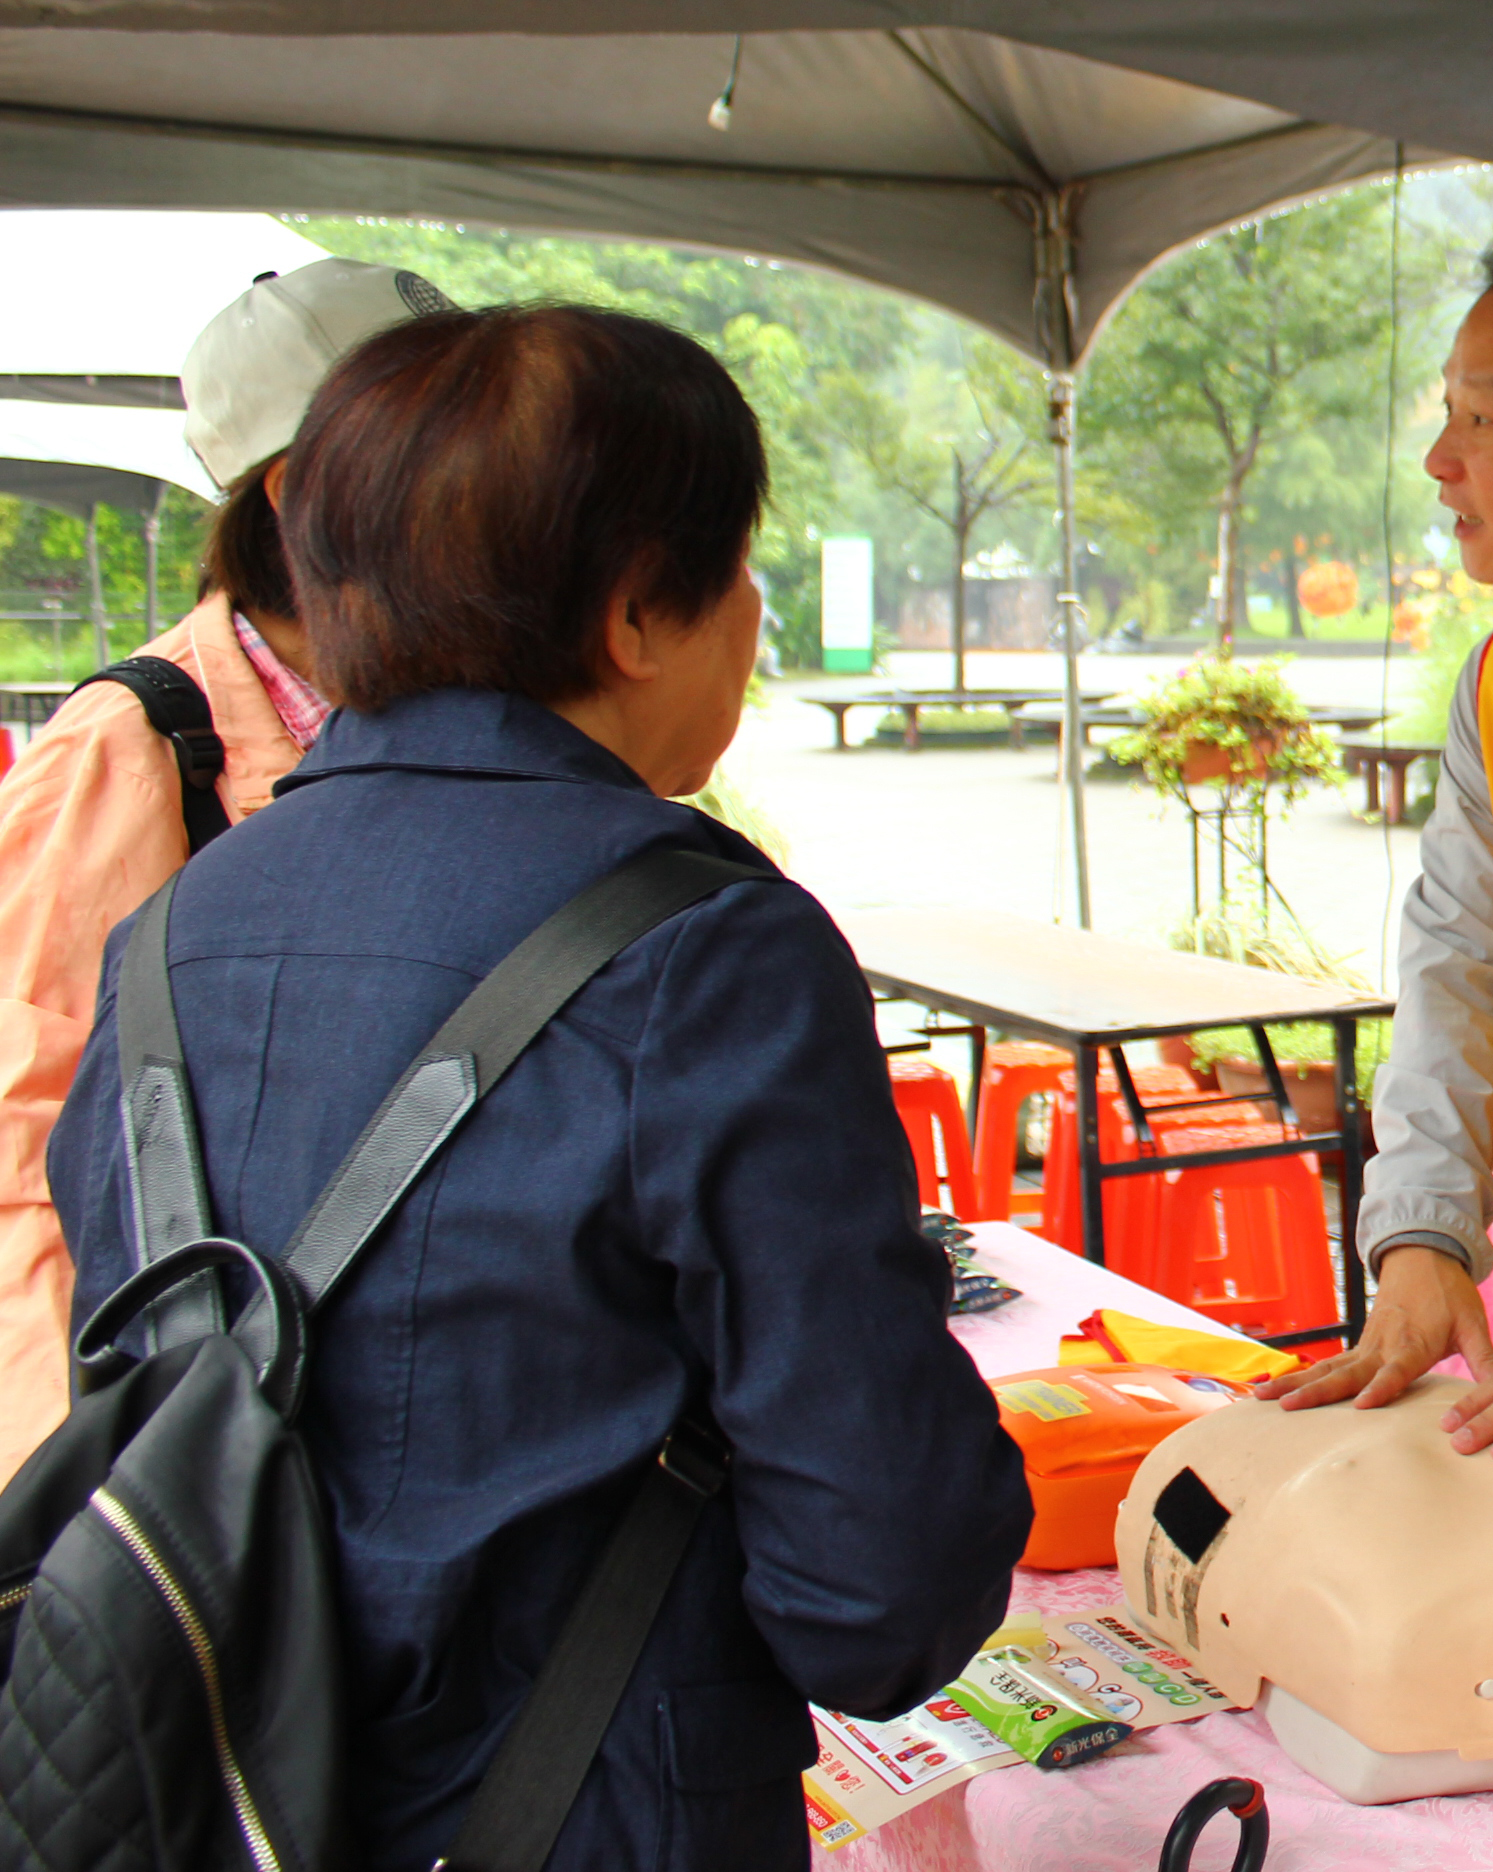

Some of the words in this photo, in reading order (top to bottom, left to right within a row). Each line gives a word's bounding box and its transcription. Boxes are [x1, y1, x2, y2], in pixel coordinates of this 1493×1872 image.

[990, 1670, 1042, 1709] 新光保全
[1065, 1727, 1119, 1757] 新光保全
